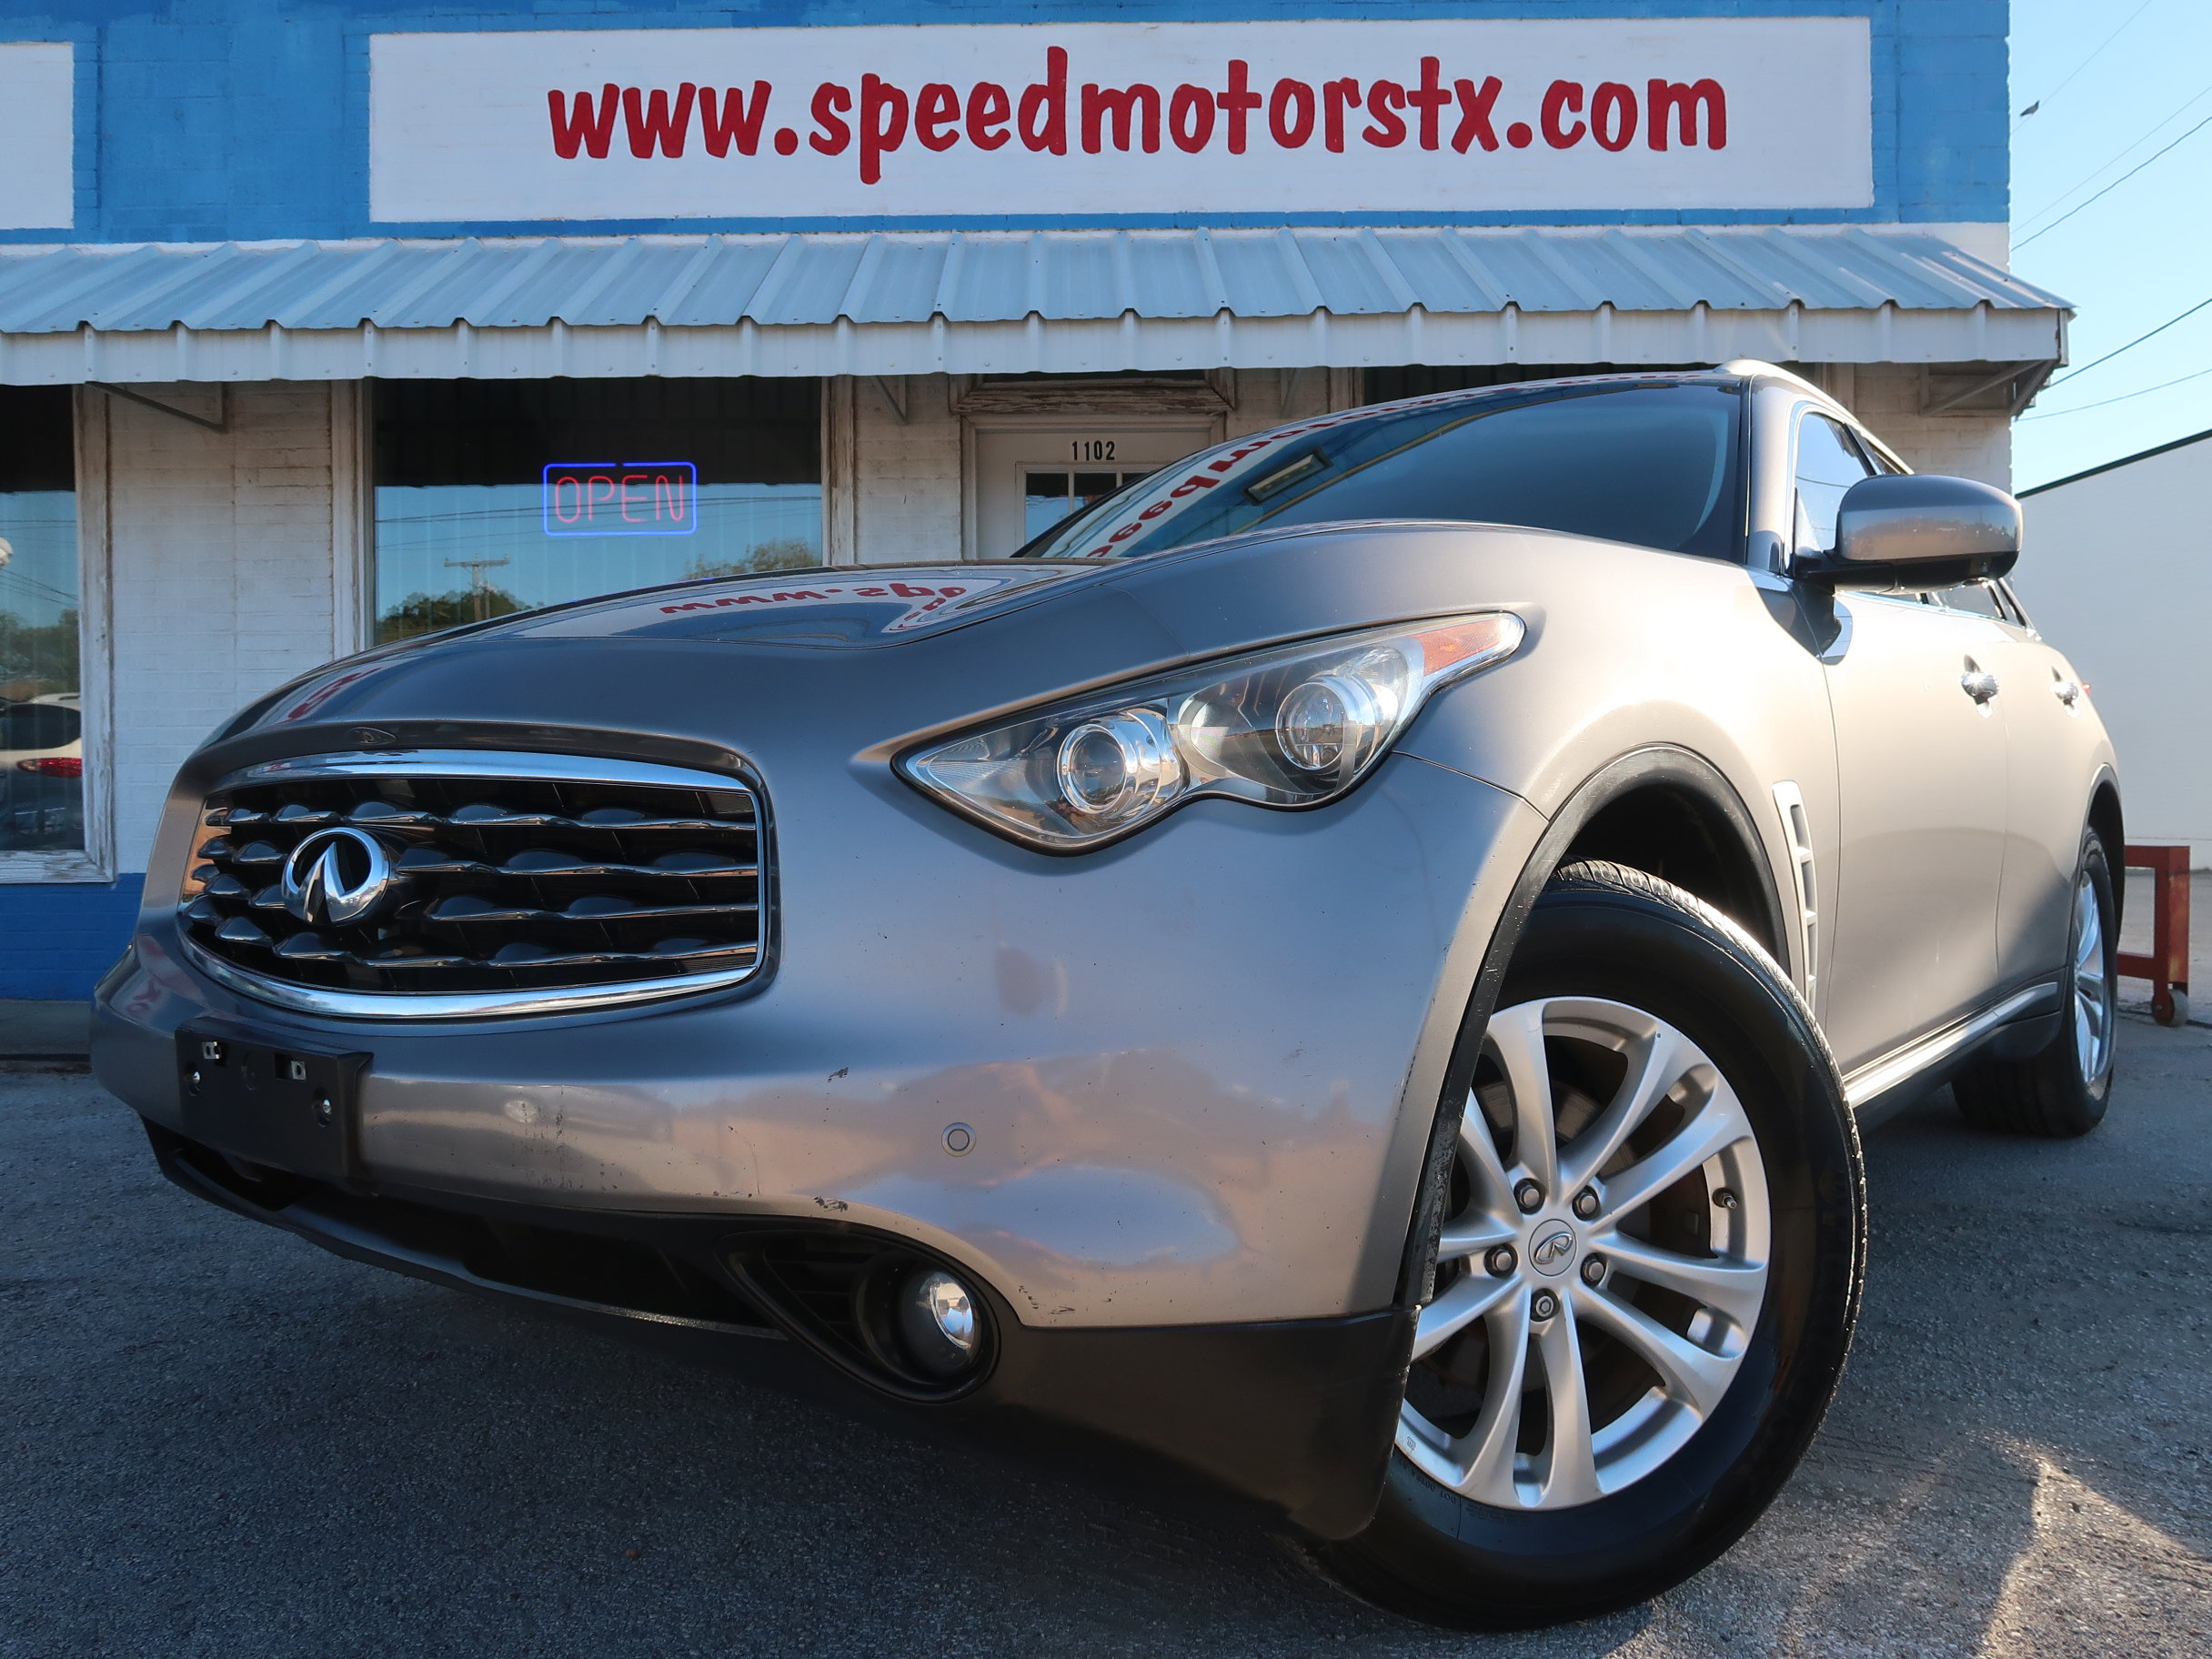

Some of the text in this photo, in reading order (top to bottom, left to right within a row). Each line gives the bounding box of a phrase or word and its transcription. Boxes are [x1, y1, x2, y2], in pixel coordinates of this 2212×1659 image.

[548, 45, 1726, 185] www.speedmotorstx.com
[1071, 439, 1115, 461] 1102
[555, 474, 685, 524] OPEN
